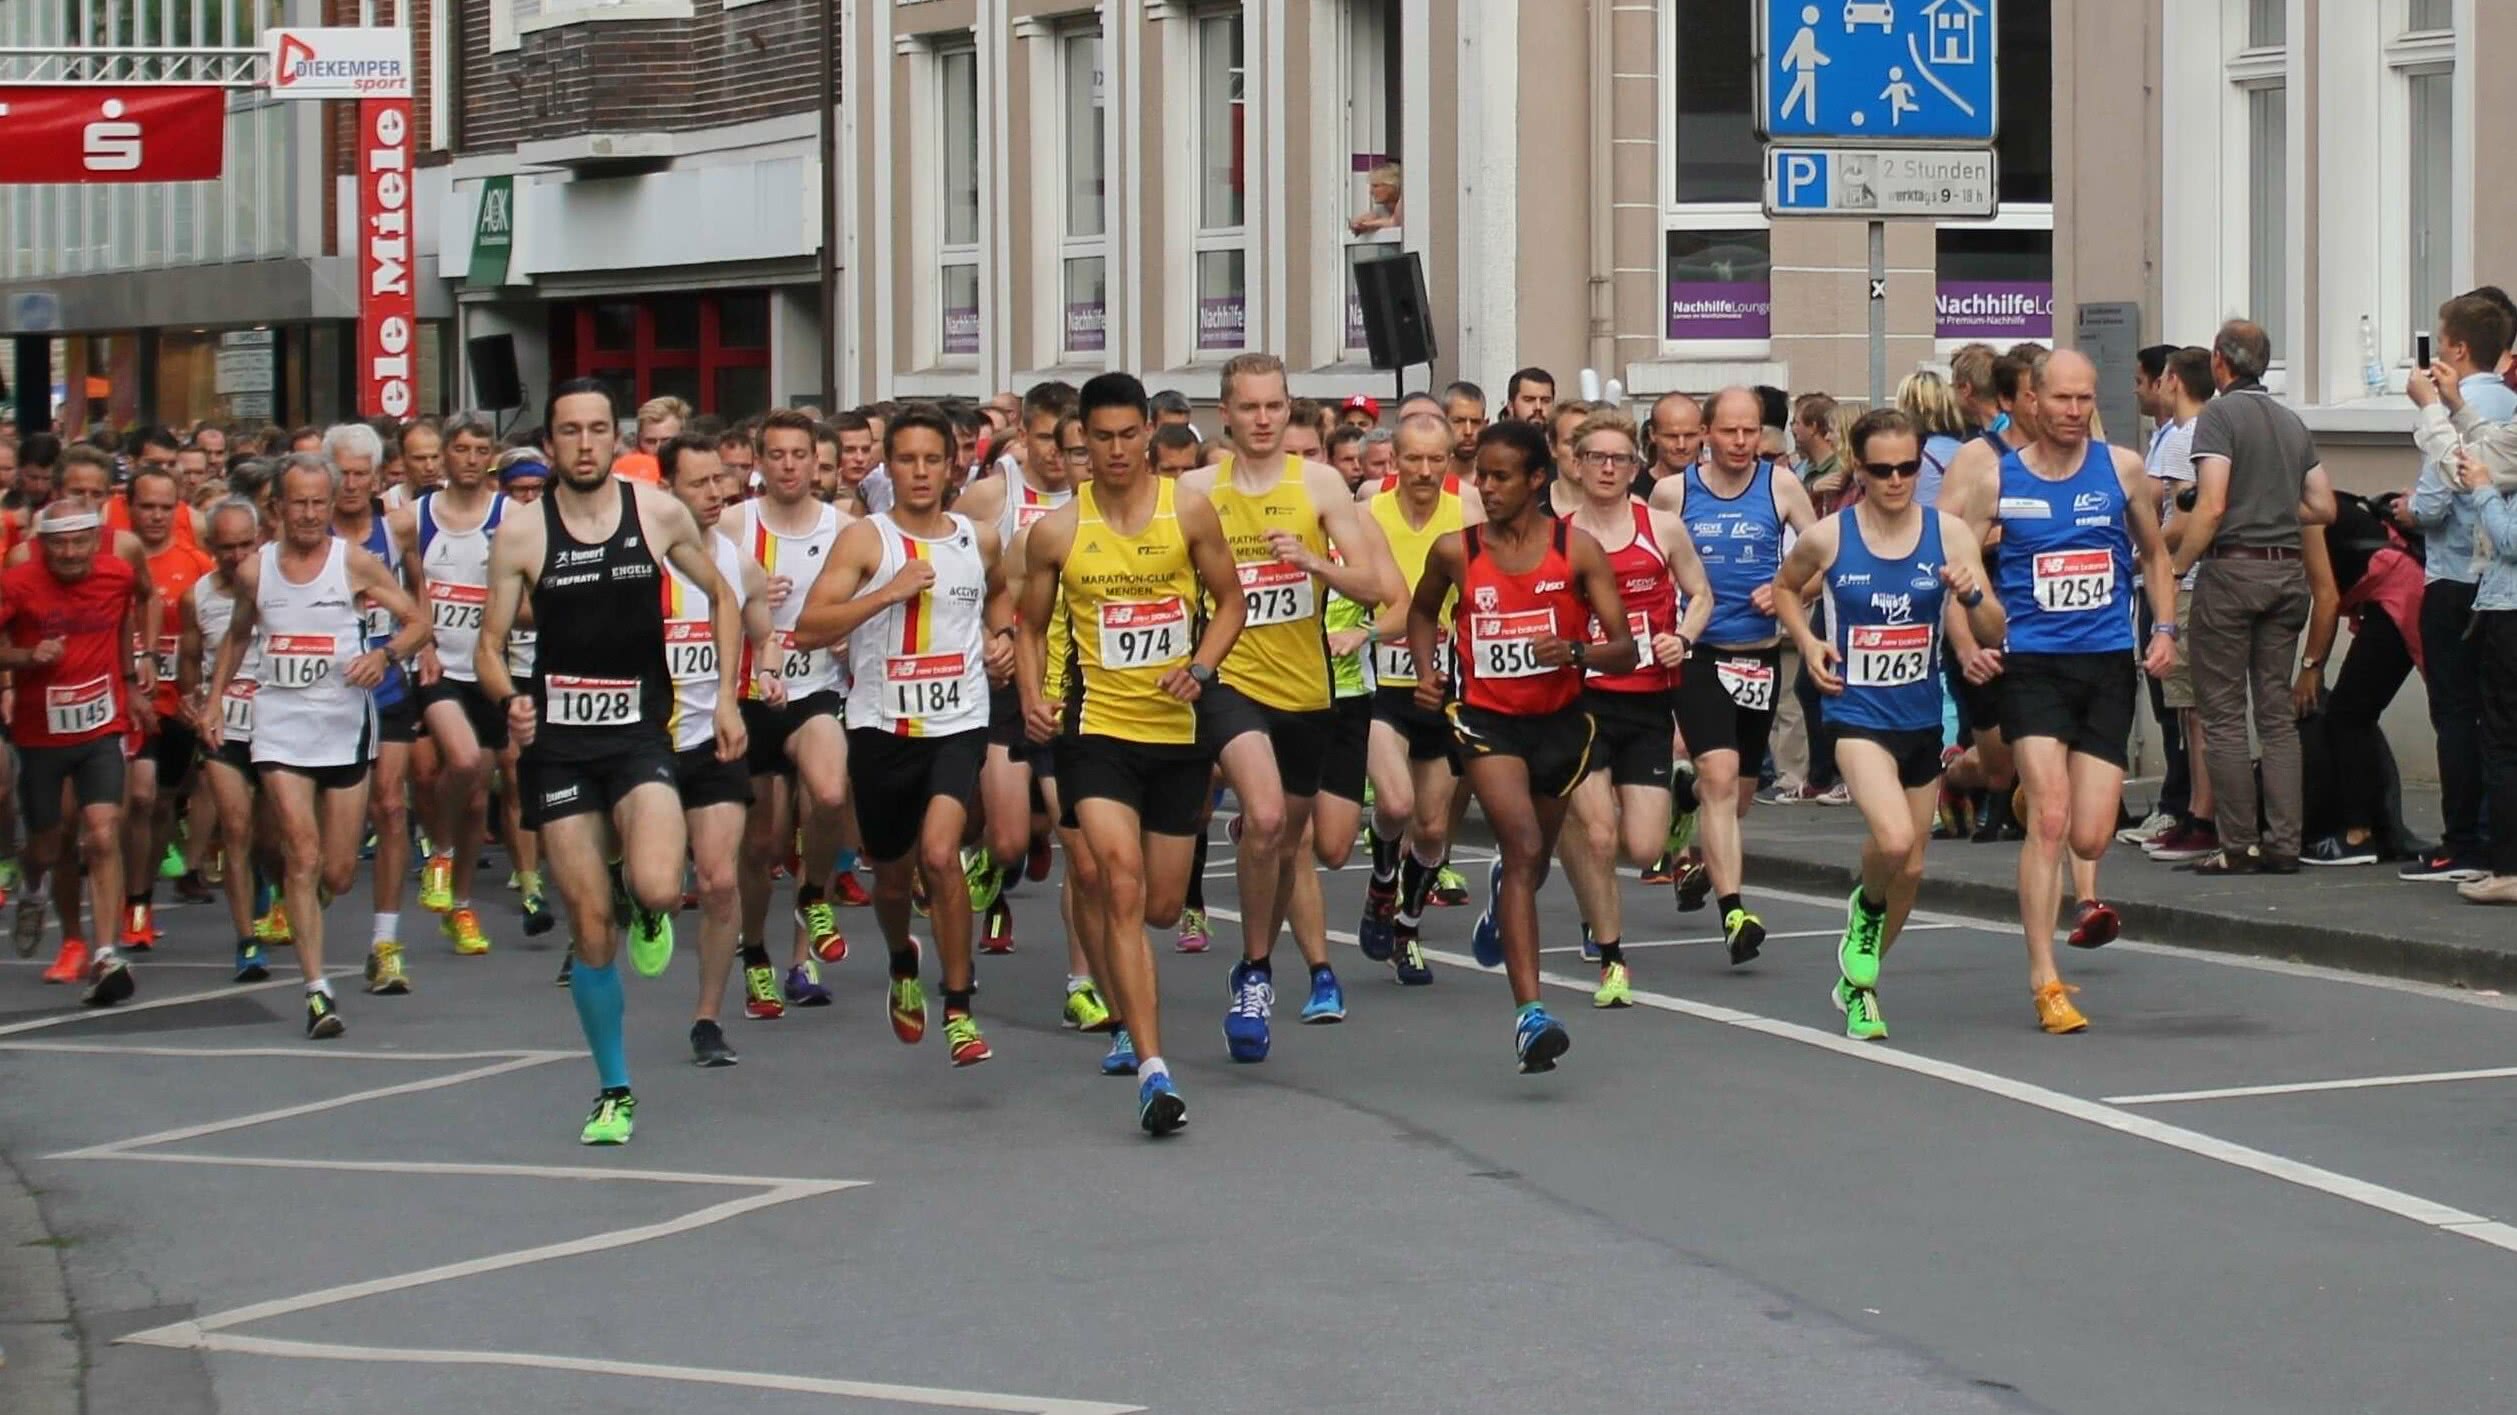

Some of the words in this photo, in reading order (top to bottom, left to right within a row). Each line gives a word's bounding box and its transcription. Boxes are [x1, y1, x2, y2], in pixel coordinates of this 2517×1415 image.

[295, 60, 401, 77] DIEKEMPER
[353, 78, 406, 93] sport
[1787, 156, 1817, 203] P
[1884, 160, 1895, 179] 2
[1904, 160, 1986, 180] Stunden
[370, 109, 406, 295] Miele
[481, 188, 509, 232] AOK
[374, 316, 411, 418] ele
[556, 573, 600, 586] REFRATH
[612, 564, 653, 577] ENGELS
[1105, 587, 1152, 596] MENDEN
[1246, 588, 1297, 619] 973
[2048, 577, 2105, 607] 1254
[433, 603, 481, 629] 1273
[1119, 627, 1171, 662] 974
[1491, 643, 1538, 672] 850
[274, 658, 329, 683] 1160
[672, 646, 719, 674] 120
[1863, 652, 1923, 681] 1263
[898, 680, 960, 713] 1184
[1732, 678, 1767, 706] 255
[60, 700, 105, 730] 1145
[563, 692, 629, 722] 1028
